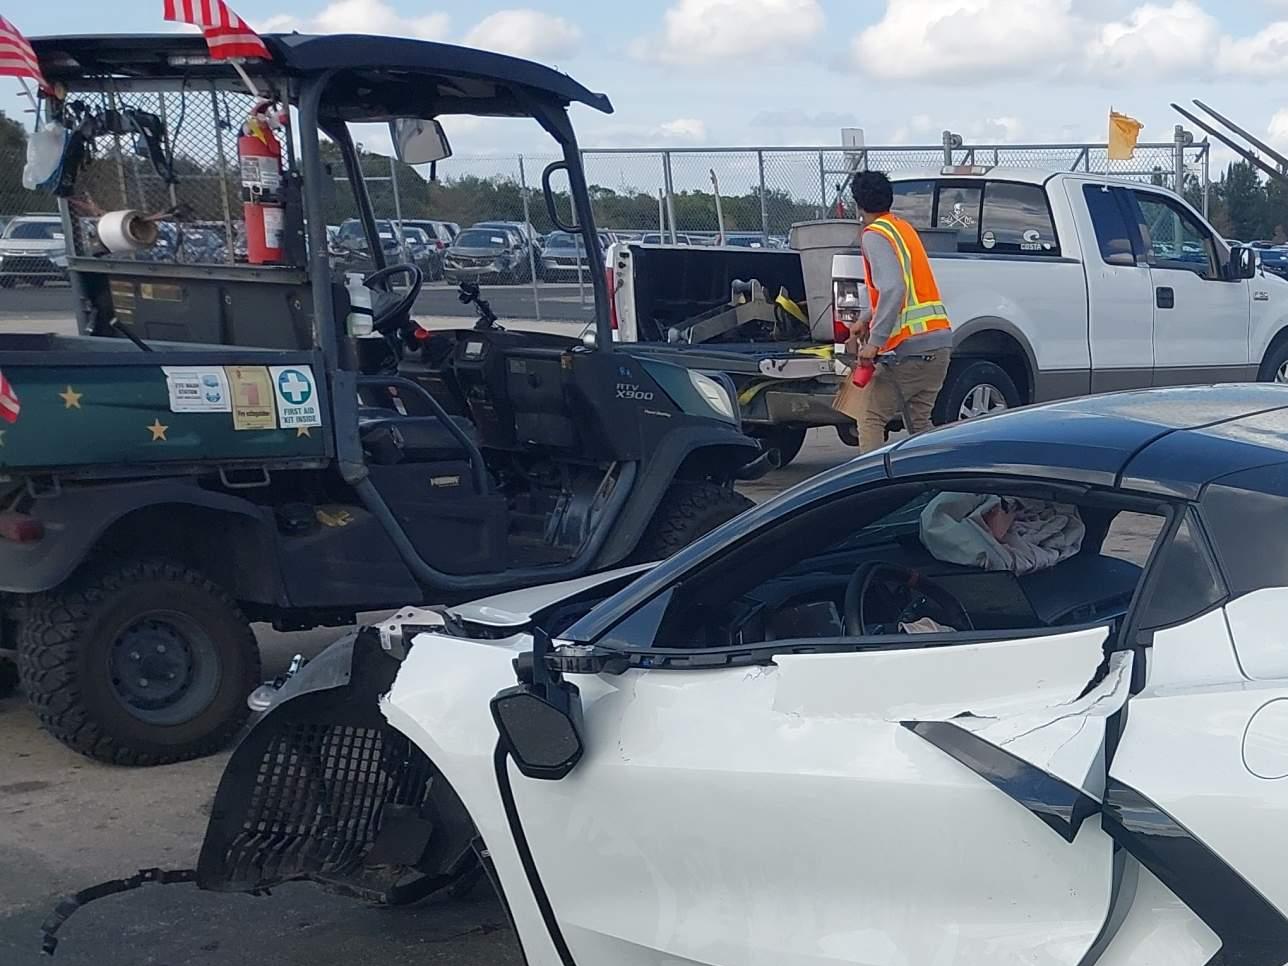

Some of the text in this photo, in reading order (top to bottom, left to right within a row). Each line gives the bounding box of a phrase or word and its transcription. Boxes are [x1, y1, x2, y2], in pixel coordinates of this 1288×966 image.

[1020, 243, 1042, 251] COSTA
[616, 383, 640, 391] RTV
[615, 389, 654, 401] X900
[283, 406, 315, 416] FIRST AID
[284, 415, 317, 424] KIT INSIDE
